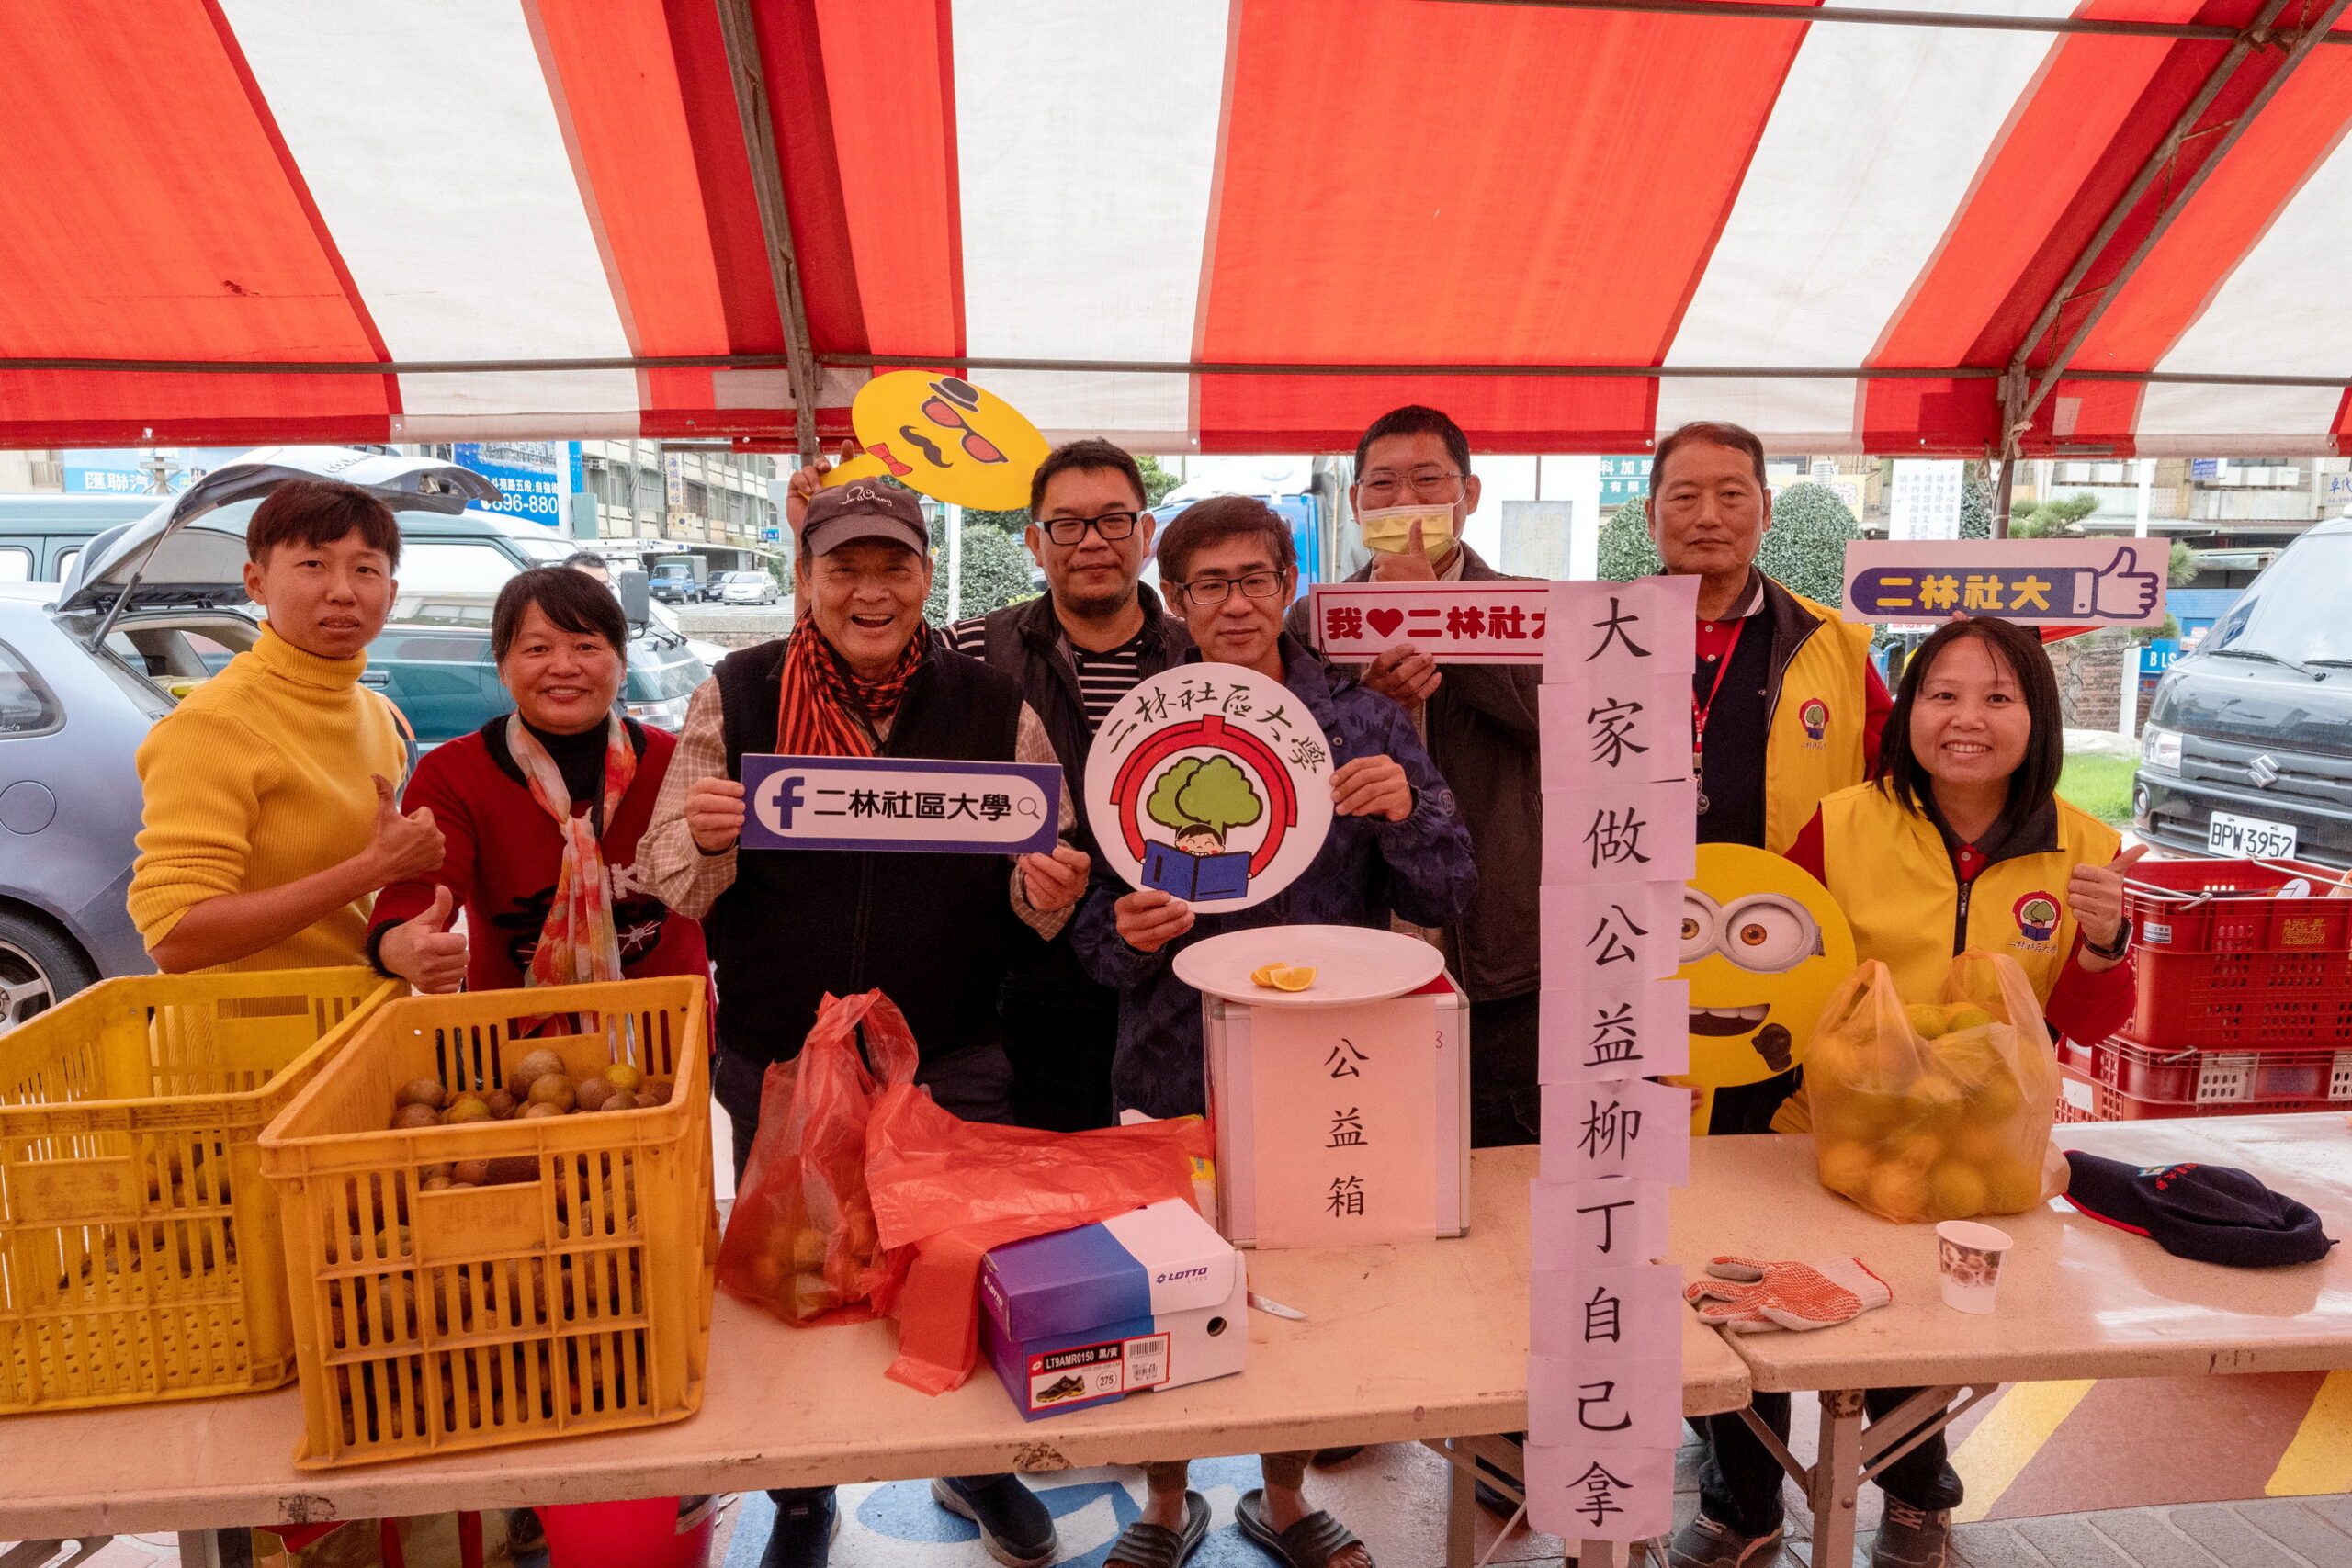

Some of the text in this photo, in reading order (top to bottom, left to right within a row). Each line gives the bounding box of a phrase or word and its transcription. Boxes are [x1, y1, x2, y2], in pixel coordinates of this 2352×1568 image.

[1878, 575, 2052, 610] 二林社大
[1107, 680, 1326, 774] 二林社區大學
[814, 788, 1012, 822] 二林社區大學
[1566, 596, 1653, 1528] 大家做公益柳丁自己拿
[1324, 1038, 1370, 1218] 公益箱
[1169, 1267, 1208, 1281] LOTTO
[1100, 1375, 1114, 1387] 275
